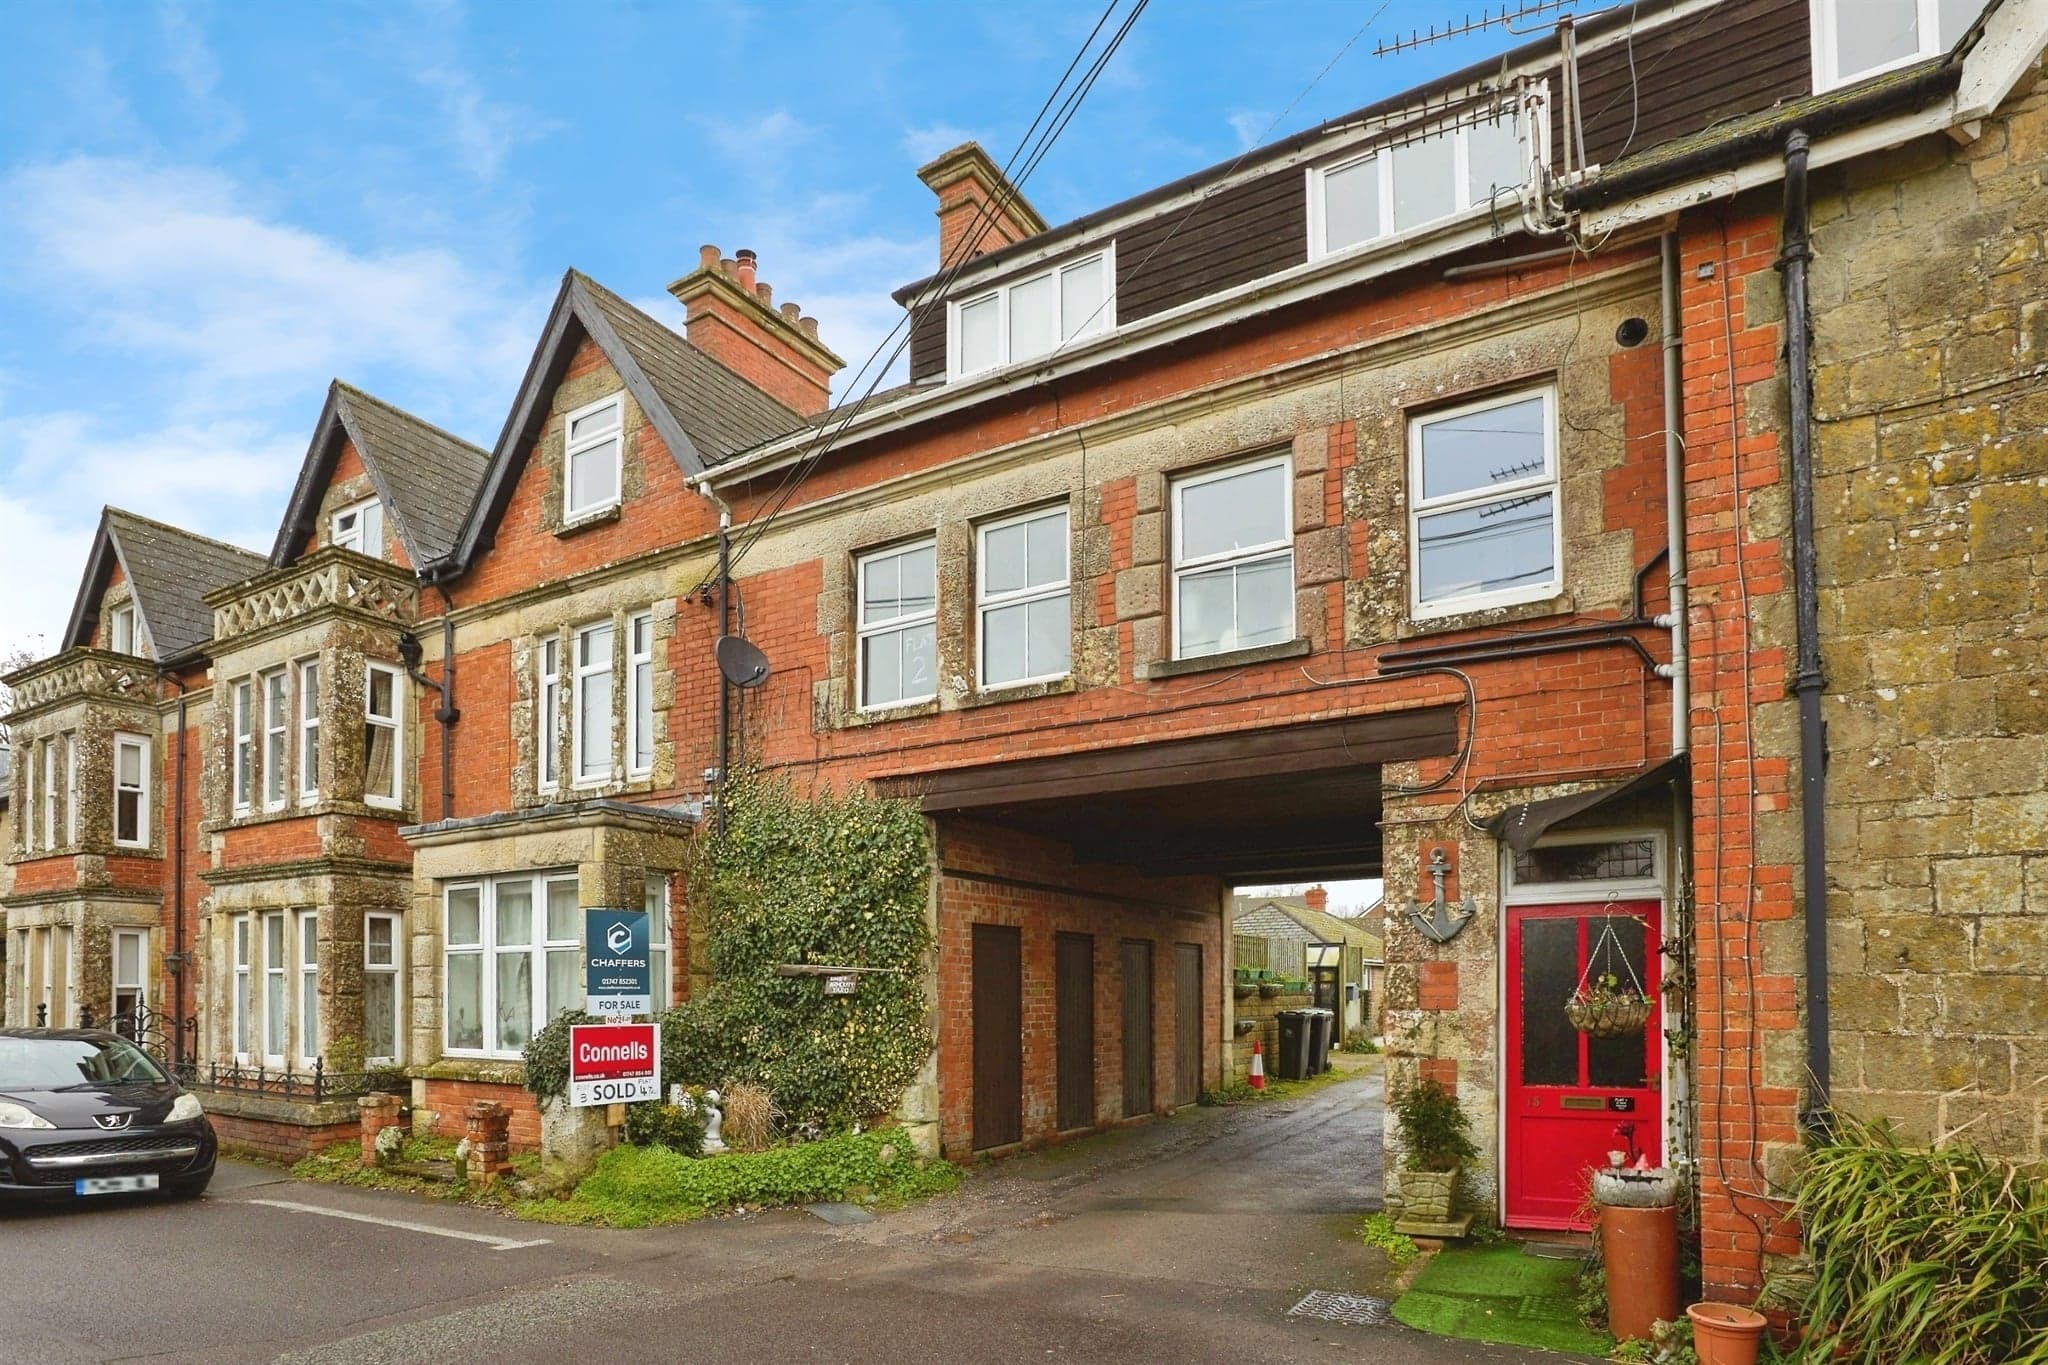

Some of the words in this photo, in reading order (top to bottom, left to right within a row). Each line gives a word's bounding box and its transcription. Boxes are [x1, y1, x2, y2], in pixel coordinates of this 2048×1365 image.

[905, 634, 935, 653] FLAT
[912, 656, 928, 684] 2
[591, 959, 646, 968] CHAFFERS
[600, 1001, 618, 1010] FOR
[620, 1000, 640, 1009] SALE
[580, 1041, 648, 1063] Connells
[593, 1083, 636, 1101] SOLD
[640, 1086, 647, 1096] 4
